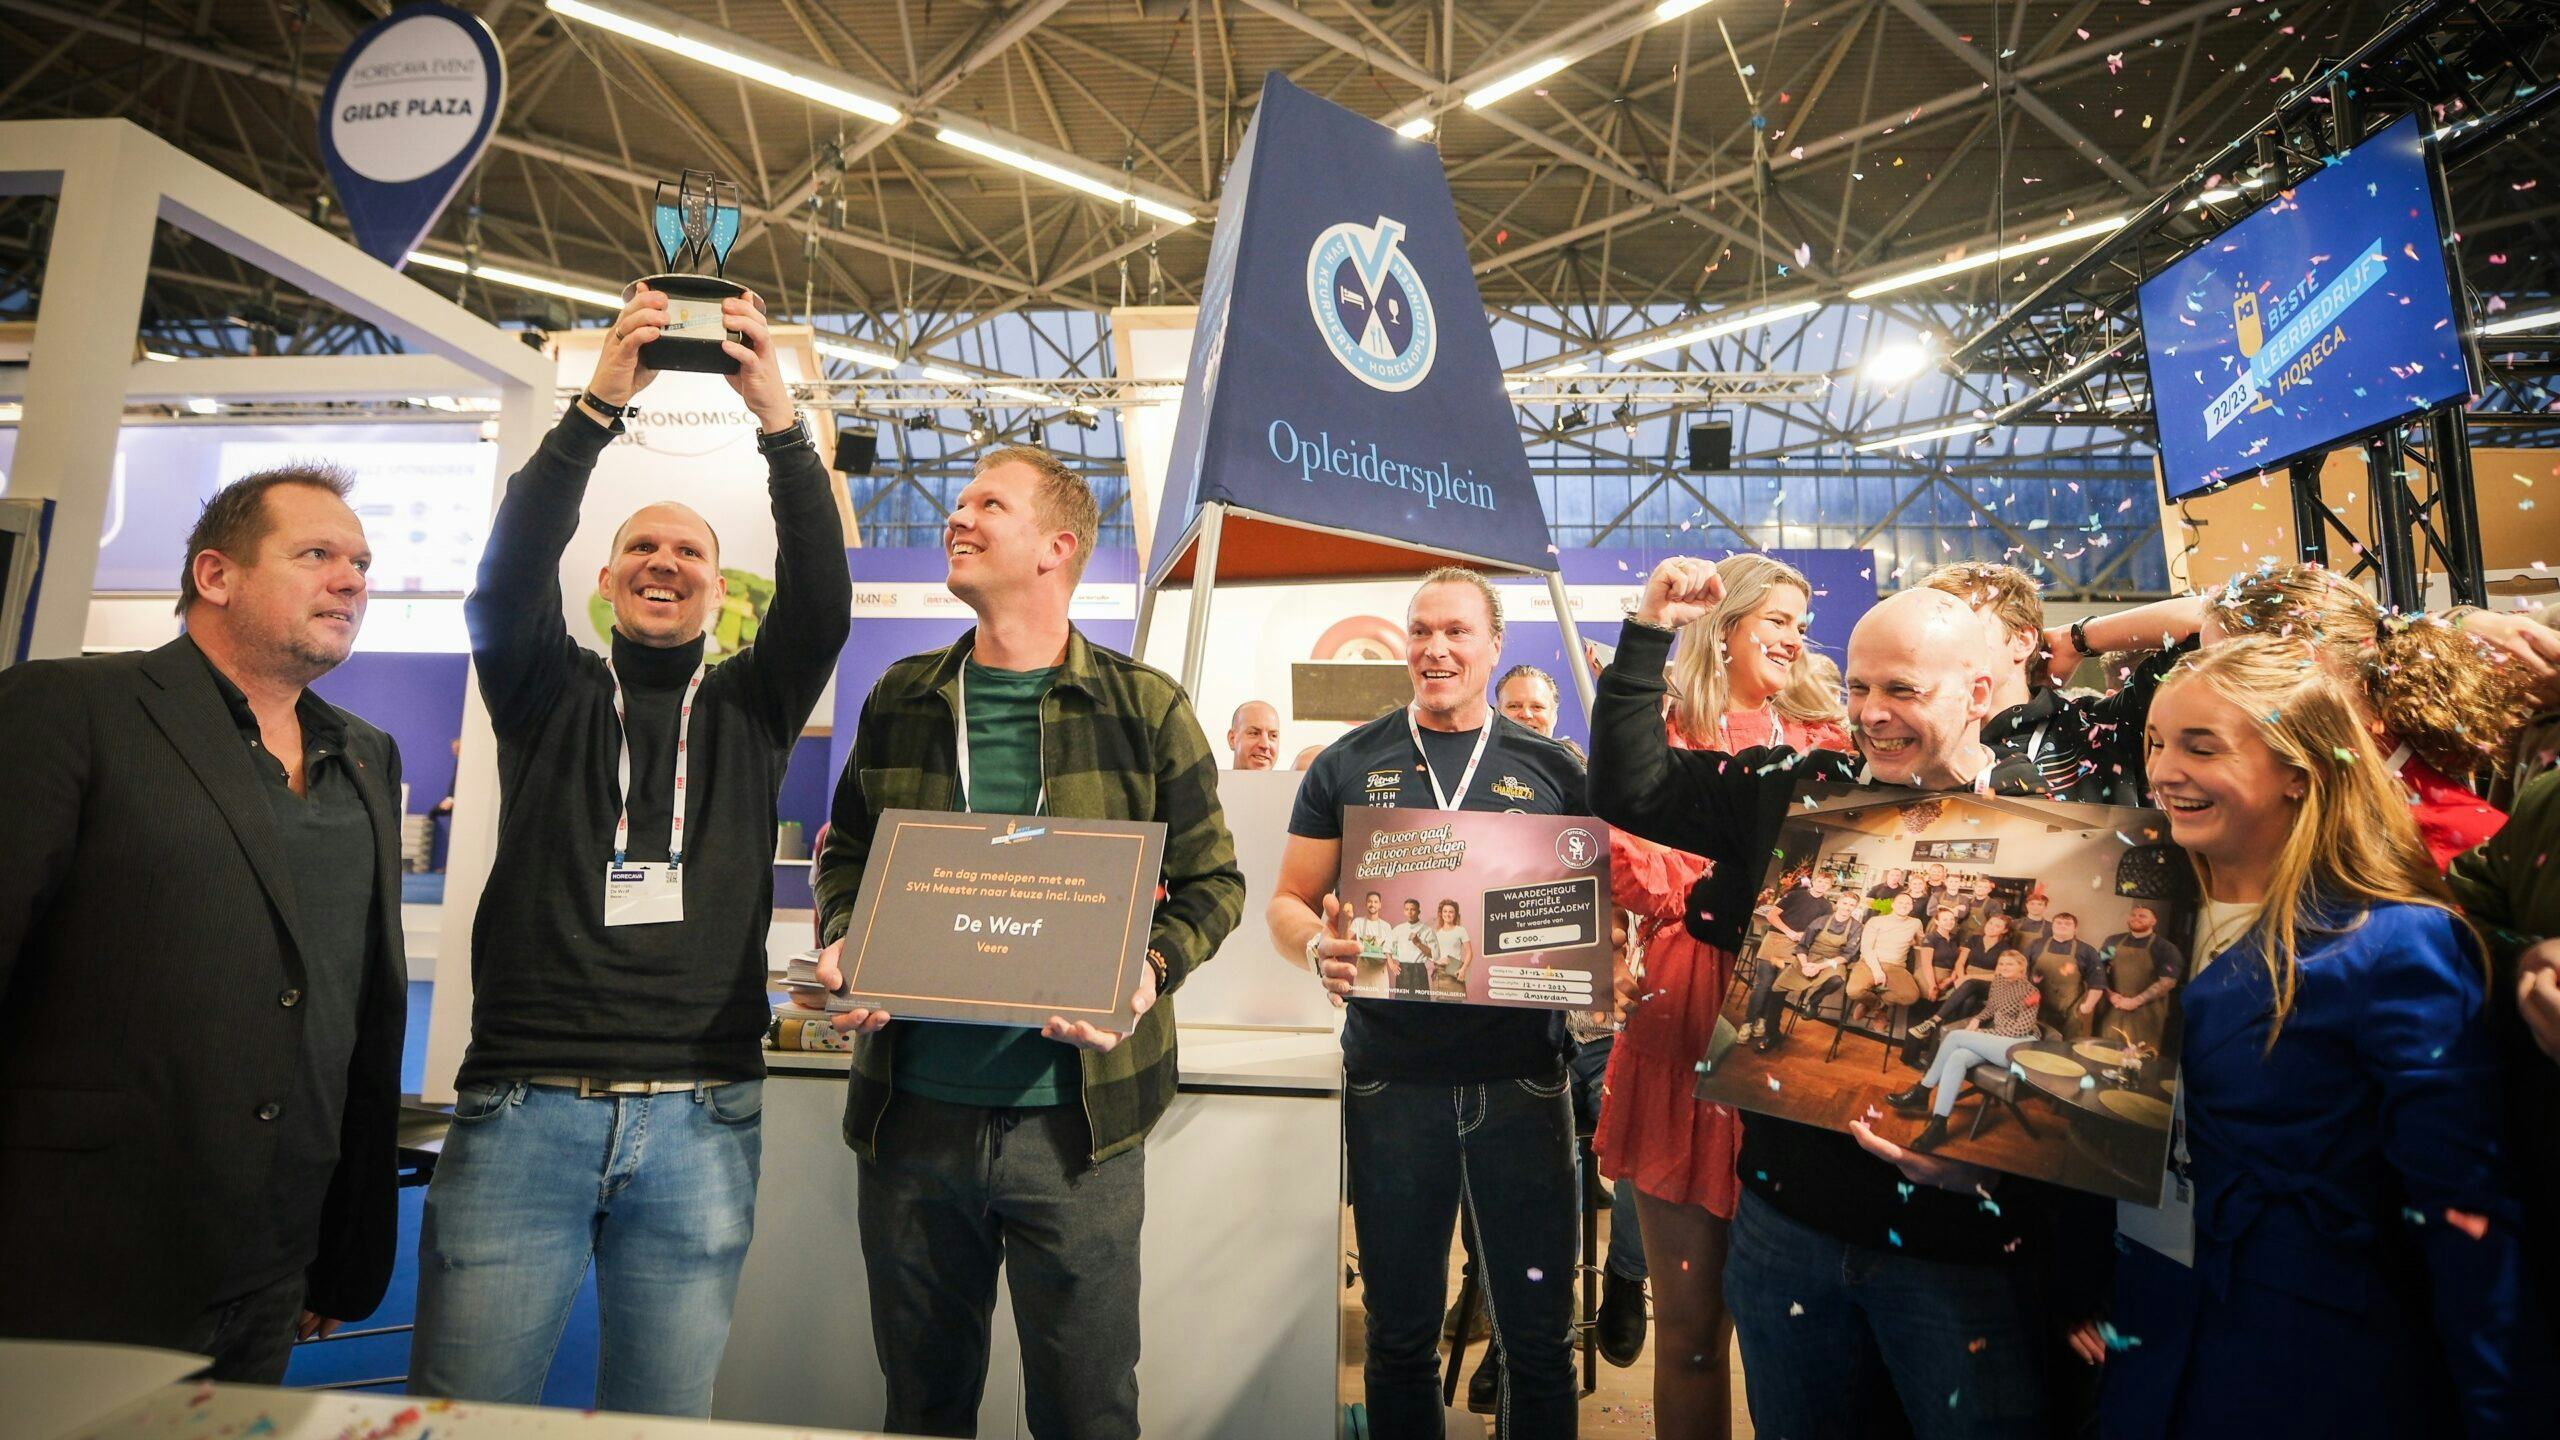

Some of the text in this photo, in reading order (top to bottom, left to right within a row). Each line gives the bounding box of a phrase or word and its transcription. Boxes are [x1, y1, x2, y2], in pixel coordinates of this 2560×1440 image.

[353, 58, 476, 81] HORECAVA EVENT
[343, 99, 472, 123] GILDE PLAZA
[2267, 268, 2319, 332] BESTE
[1319, 269, 1354, 357] KEURMERK
[2259, 256, 2373, 375] LEERBEDRIJF
[2277, 325, 2347, 397] HORECA
[1268, 419, 1497, 511] Opleidersplein
[1369, 791, 1396, 802] HIGH
[1372, 824, 1452, 848] Ga voor gaaf,
[1364, 840, 1465, 864] ga voor een eigen
[933, 867, 1086, 887] Een dag meelopen met een
[1357, 853, 1463, 878] bedrijfsacademy!
[906, 881, 1106, 904] SVH Meester naar keuze incl. lunch
[1503, 885, 1577, 901] WAARDECHEQUE
[1519, 896, 1561, 909] OFFICIËLE
[1490, 902, 1591, 922] SVH BEDRIJFSACADEMY
[1527, 919, 1551, 927] waarde
[953, 913, 1044, 937] De Werf
[976, 941, 1009, 954] Veere
